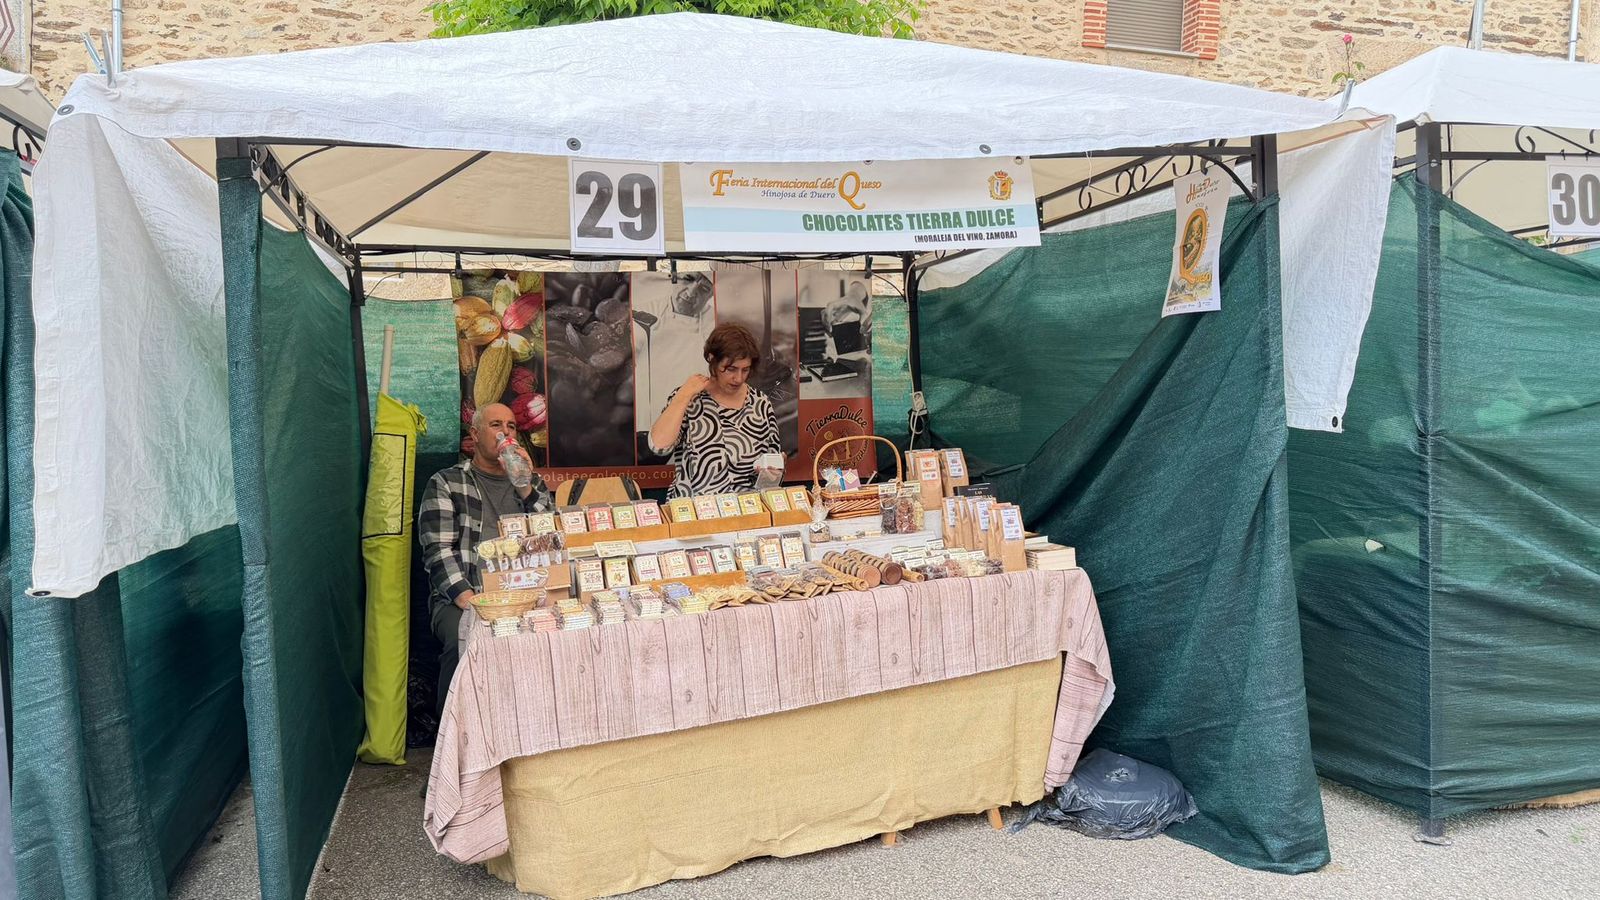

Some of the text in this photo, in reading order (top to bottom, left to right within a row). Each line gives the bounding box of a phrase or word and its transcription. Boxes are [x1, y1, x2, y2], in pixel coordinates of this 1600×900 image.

[574, 171, 658, 240] 29
[709, 169, 882, 211] Feria Internacional del Queso
[761, 189, 836, 200] Hinojosa de Duero
[1551, 172, 1600, 227] 30
[802, 208, 1016, 232] CHOCOLATES TIERRA DULCE
[953, 233, 965, 242] DEL
[986, 230, 1018, 241] ZAMORA)
